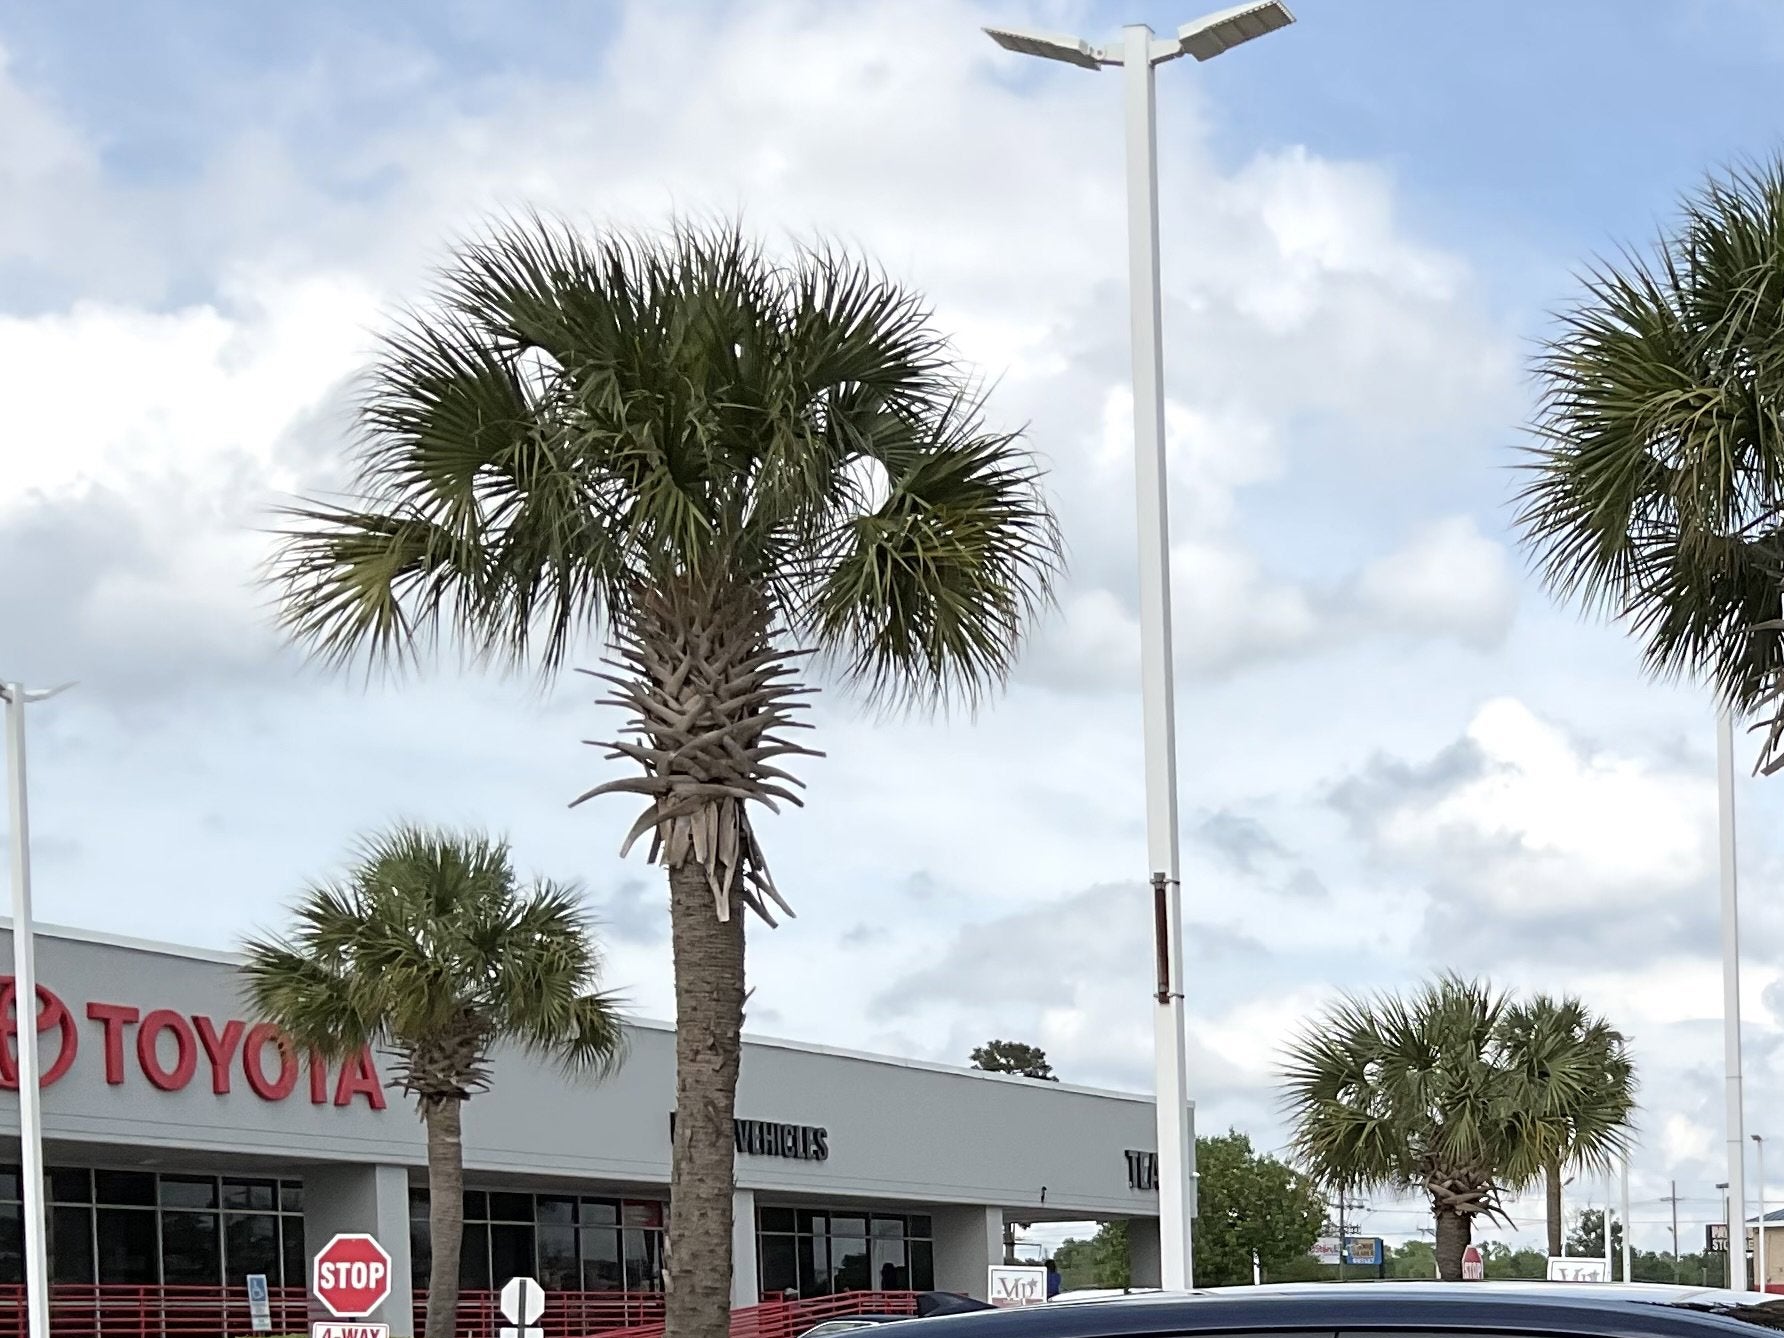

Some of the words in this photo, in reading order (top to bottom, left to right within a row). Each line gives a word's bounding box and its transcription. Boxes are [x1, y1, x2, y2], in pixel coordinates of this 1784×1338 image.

[87, 1001, 387, 1110] TOYOTA
[734, 1118, 829, 1161] VEHICLES
[1124, 1149, 1160, 1191] TEA
[320, 1261, 386, 1290] STOP
